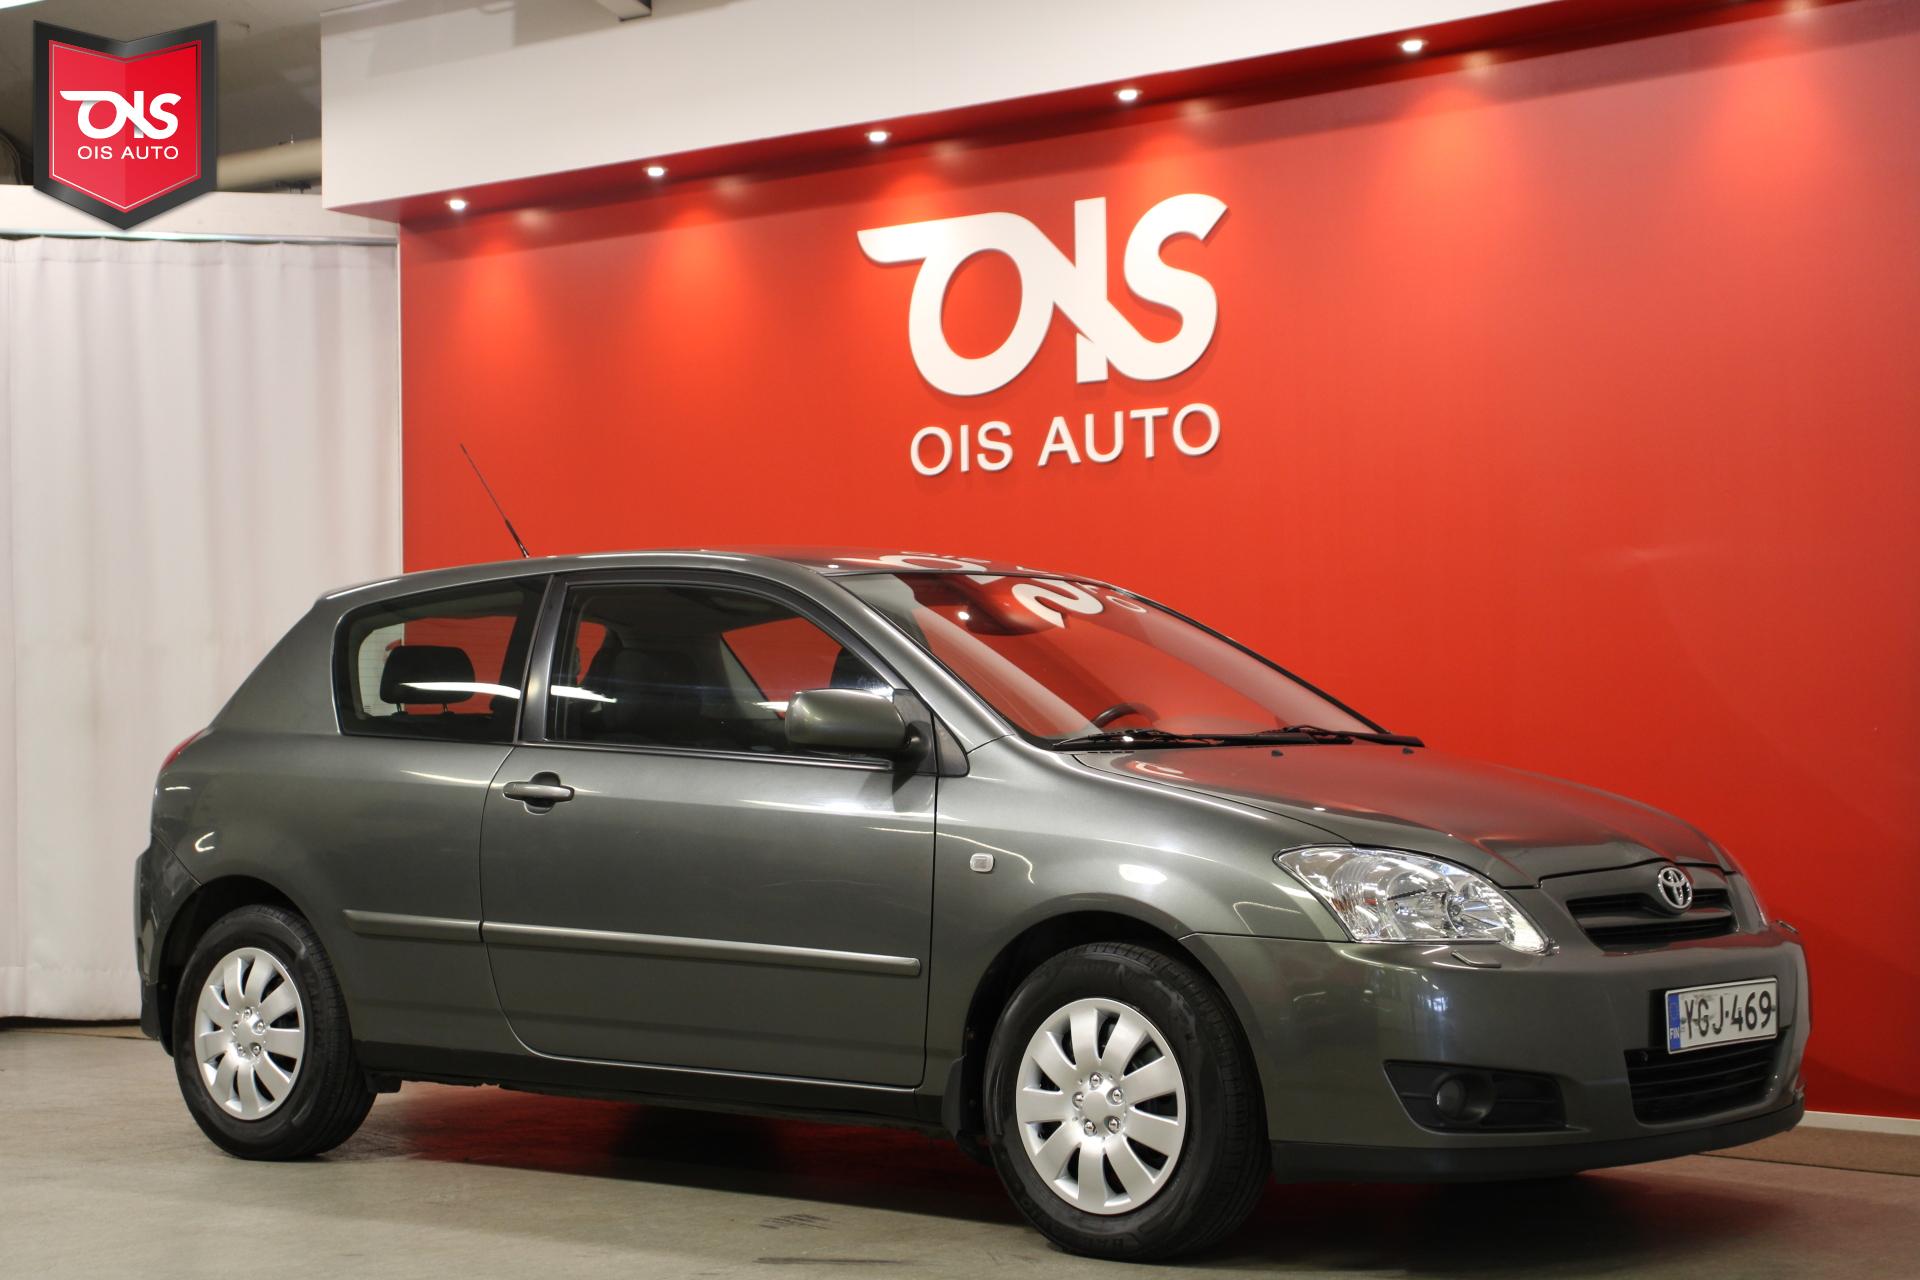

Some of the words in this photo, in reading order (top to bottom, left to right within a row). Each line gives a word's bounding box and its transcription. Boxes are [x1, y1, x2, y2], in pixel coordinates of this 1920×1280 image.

[857, 193, 1229, 396] OIS
[910, 420, 1014, 476] OIS
[1037, 402, 1222, 467] AUTO
